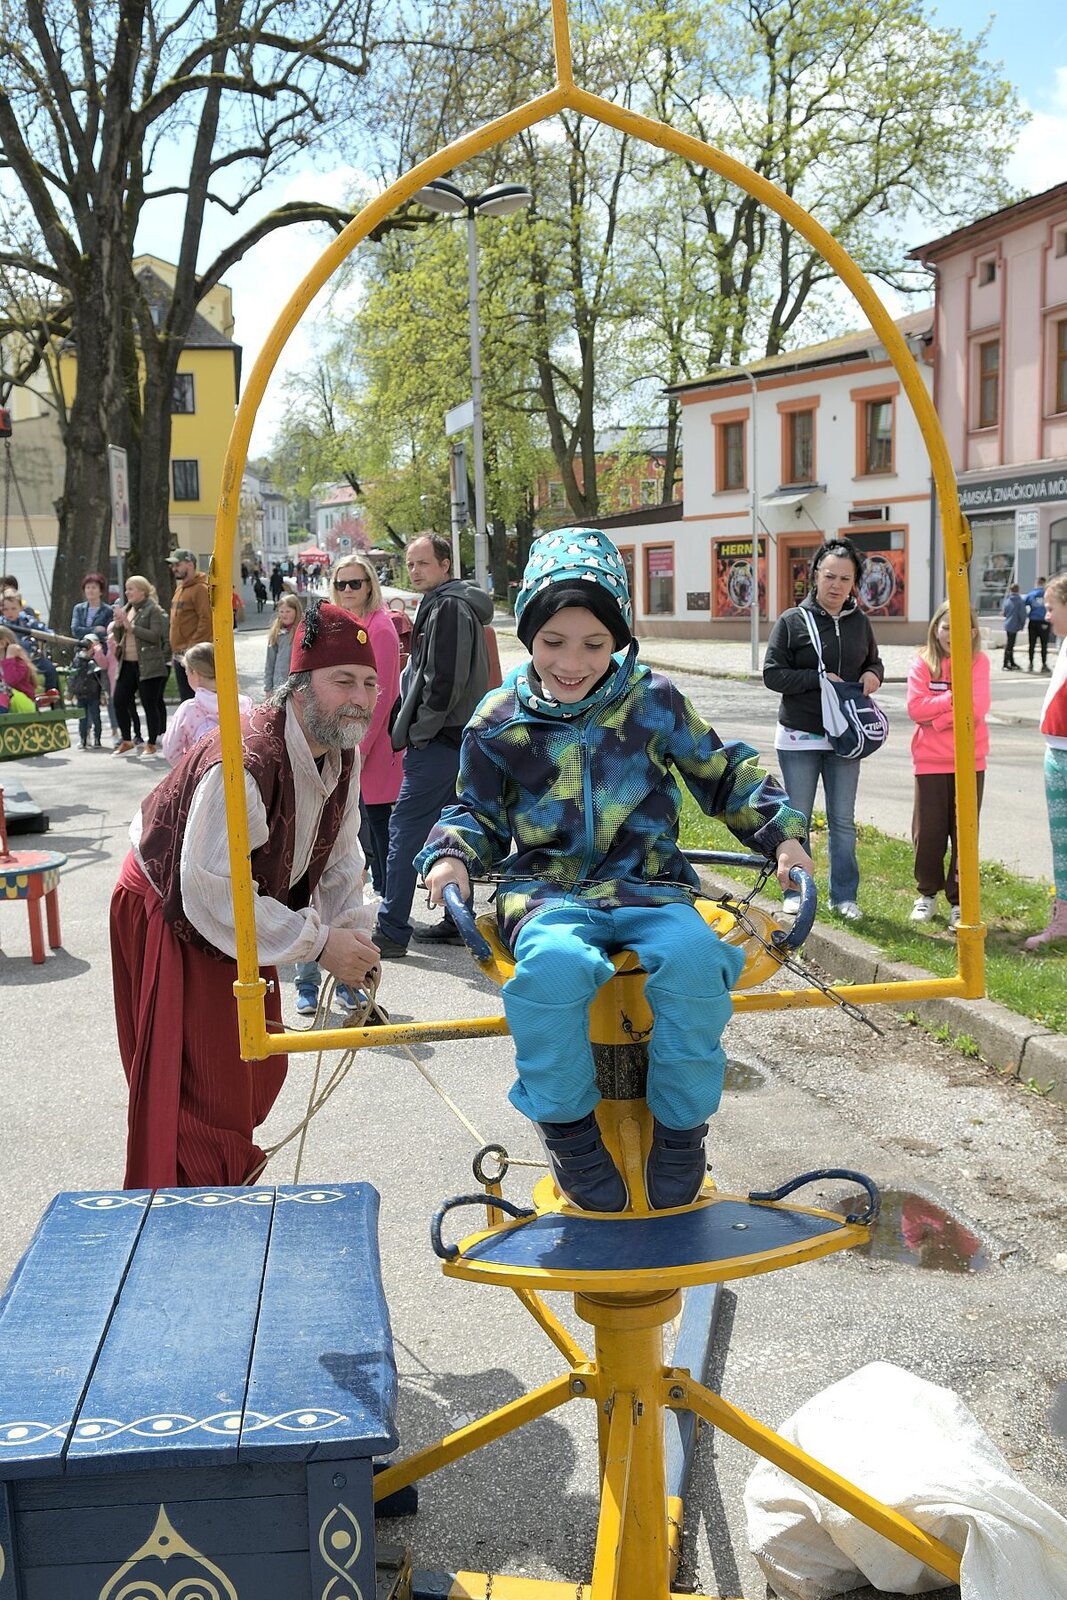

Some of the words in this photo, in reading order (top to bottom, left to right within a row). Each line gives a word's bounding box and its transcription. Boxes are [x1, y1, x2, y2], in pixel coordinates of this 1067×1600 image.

[993, 478, 1047, 502] ZNAČKOVÁ
[1047, 476, 1067, 494] MÓ
[720, 542, 763, 556] HERNA
